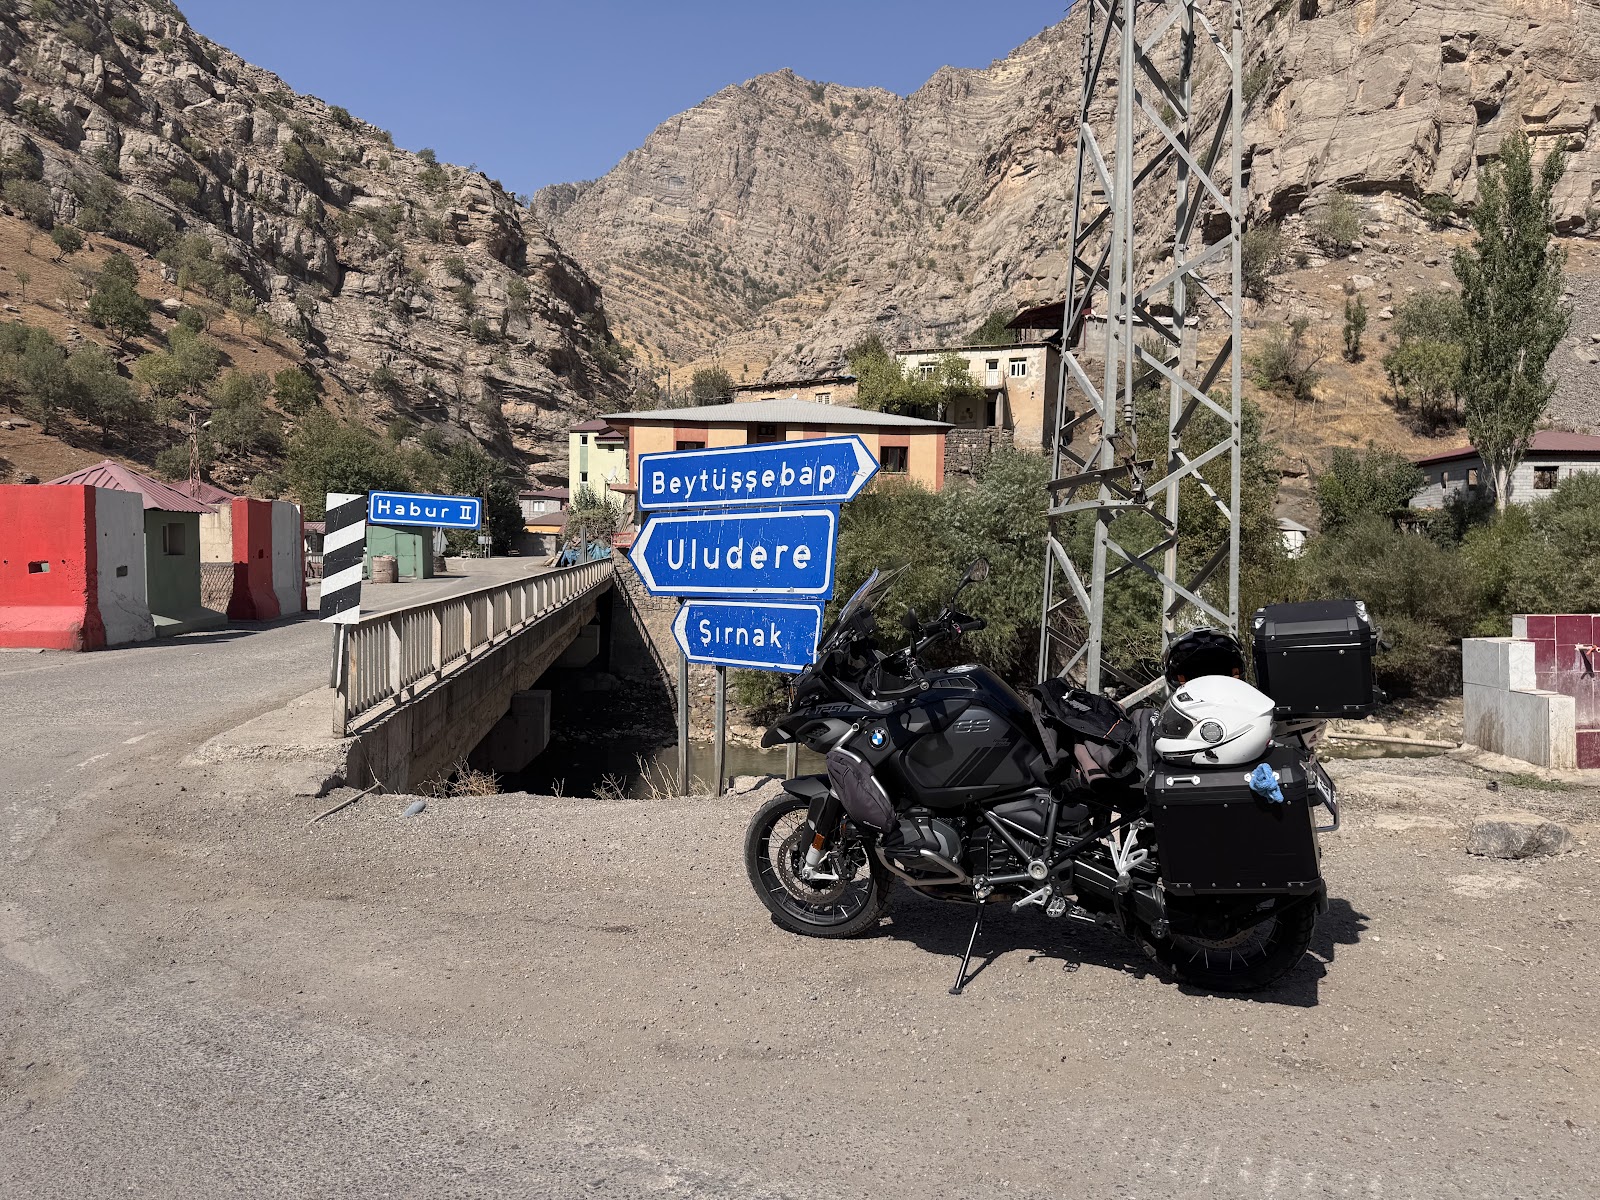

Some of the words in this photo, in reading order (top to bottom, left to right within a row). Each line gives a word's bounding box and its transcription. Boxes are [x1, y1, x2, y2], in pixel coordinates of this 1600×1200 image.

[652, 462, 836, 499] Beytüşşebap
[378, 500, 449, 518] Habur
[459, 505, 472, 520] II
[667, 538, 812, 570] Uludere
[699, 619, 782, 648] Şırnak
